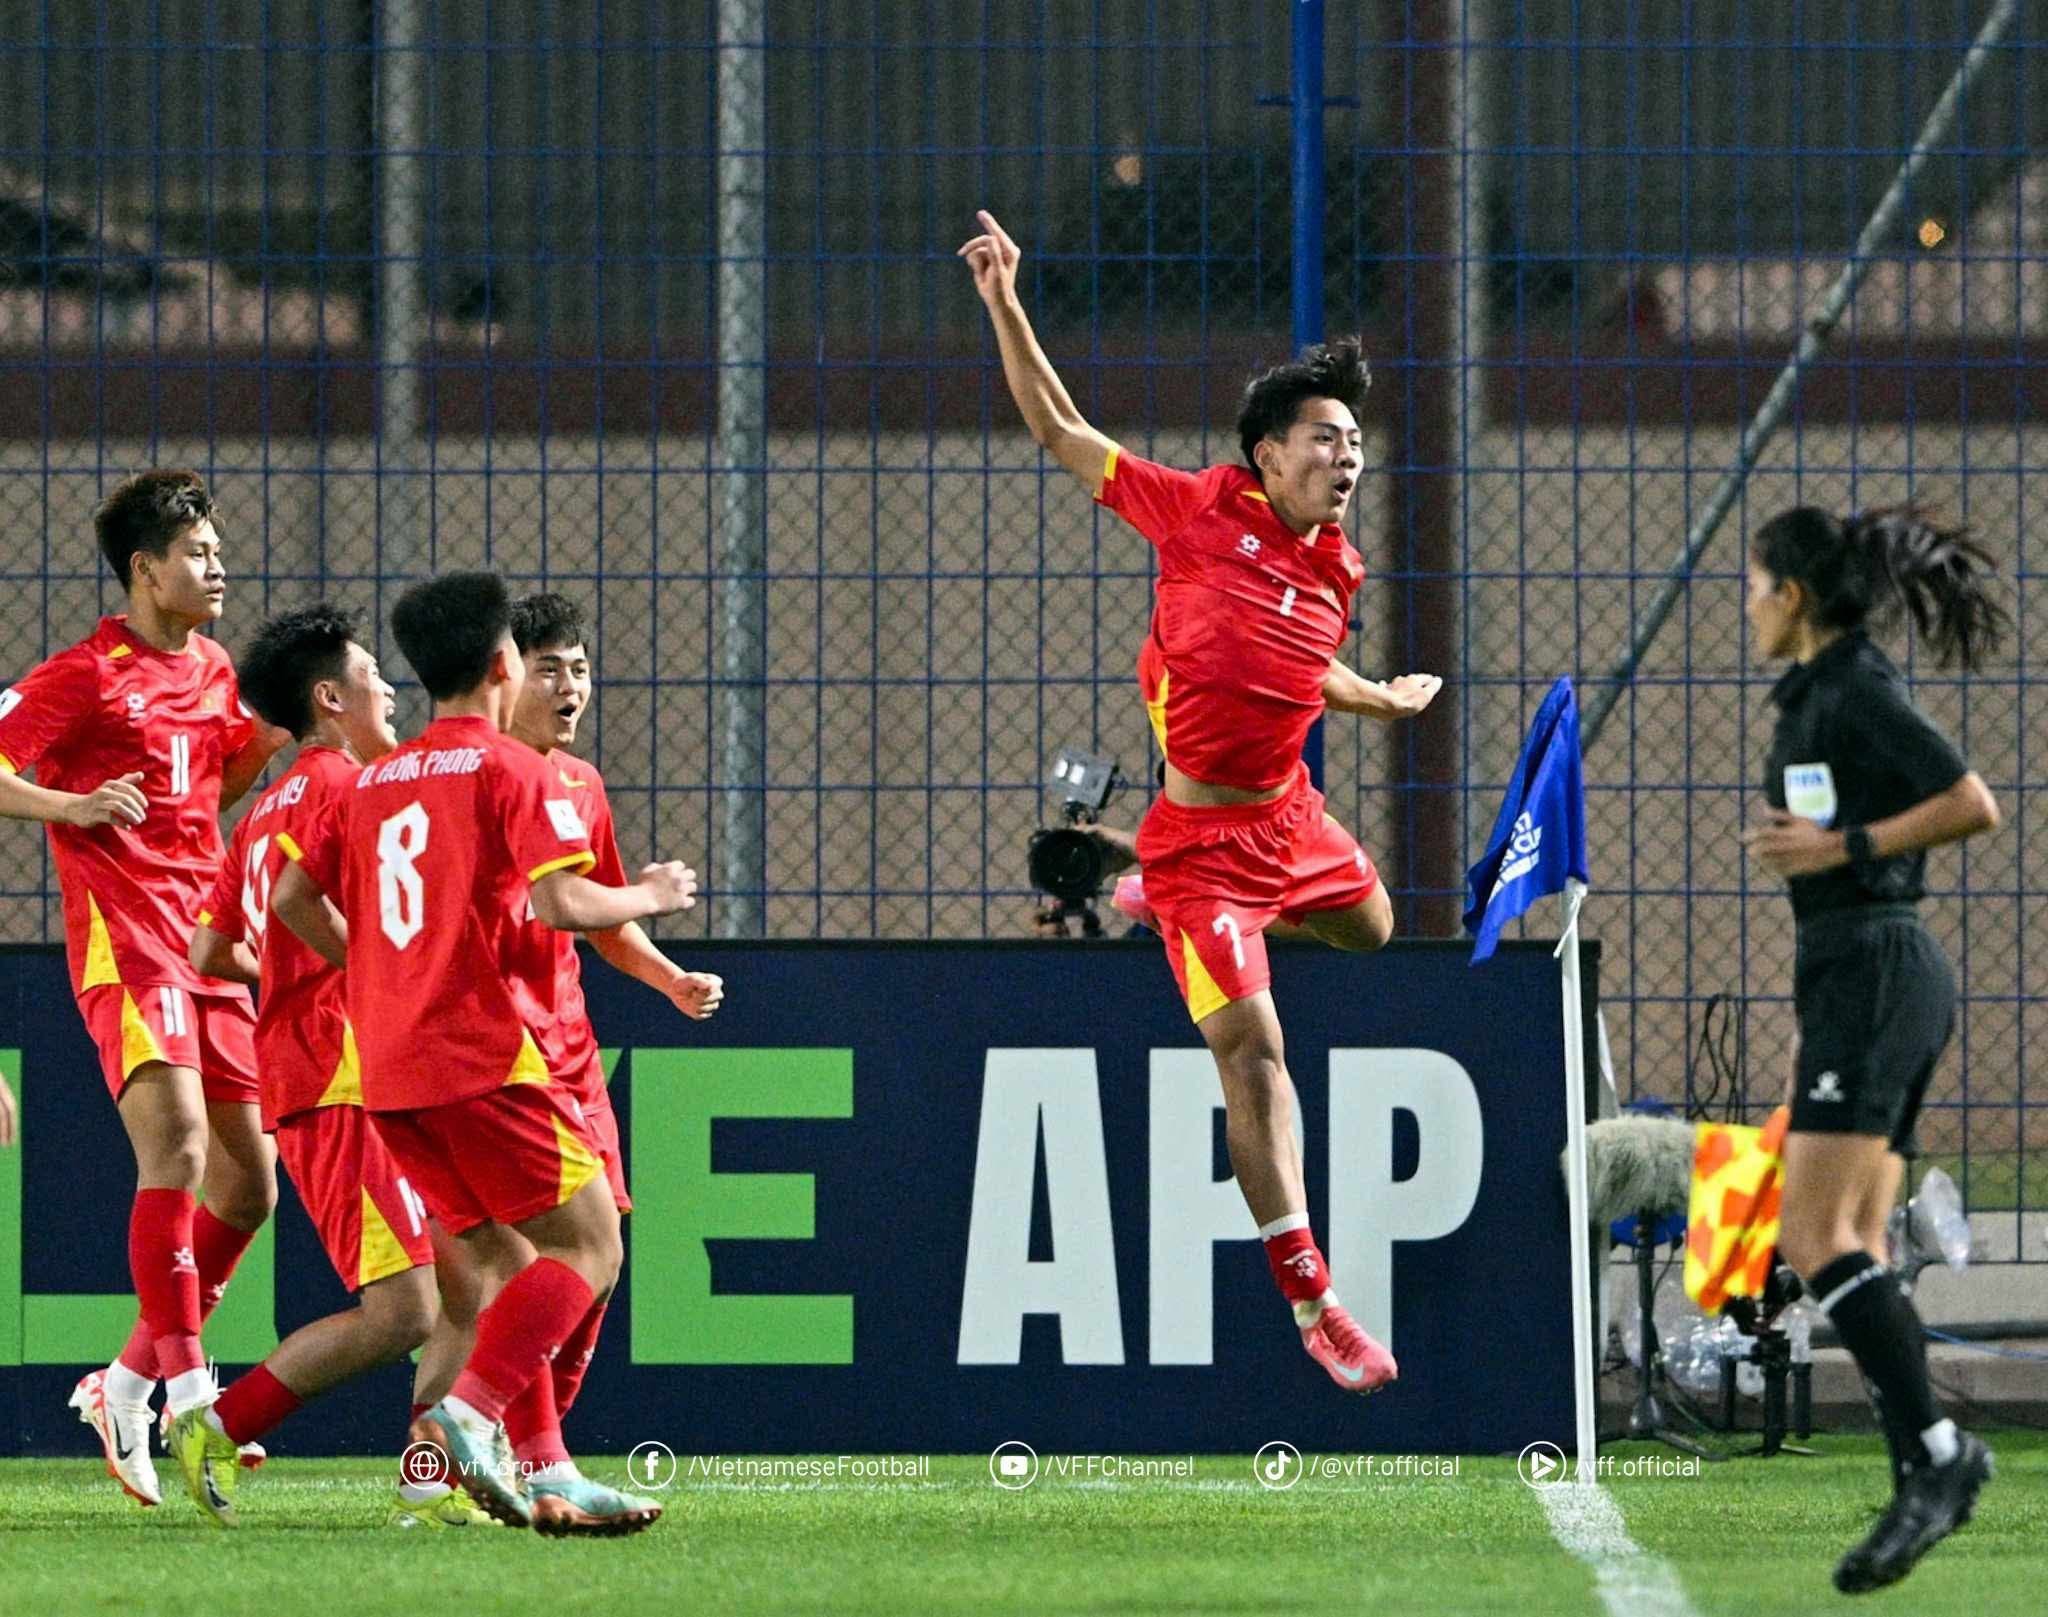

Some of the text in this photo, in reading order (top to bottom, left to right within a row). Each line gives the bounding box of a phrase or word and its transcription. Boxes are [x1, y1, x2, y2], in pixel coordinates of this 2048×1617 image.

[170, 734, 191, 796] 11
[422, 747, 488, 778] PHONG
[376, 800, 431, 951] 8
[1211, 911, 1246, 971] 7
[159, 986, 187, 1036] 11
[957, 1047, 1484, 1366] APP
